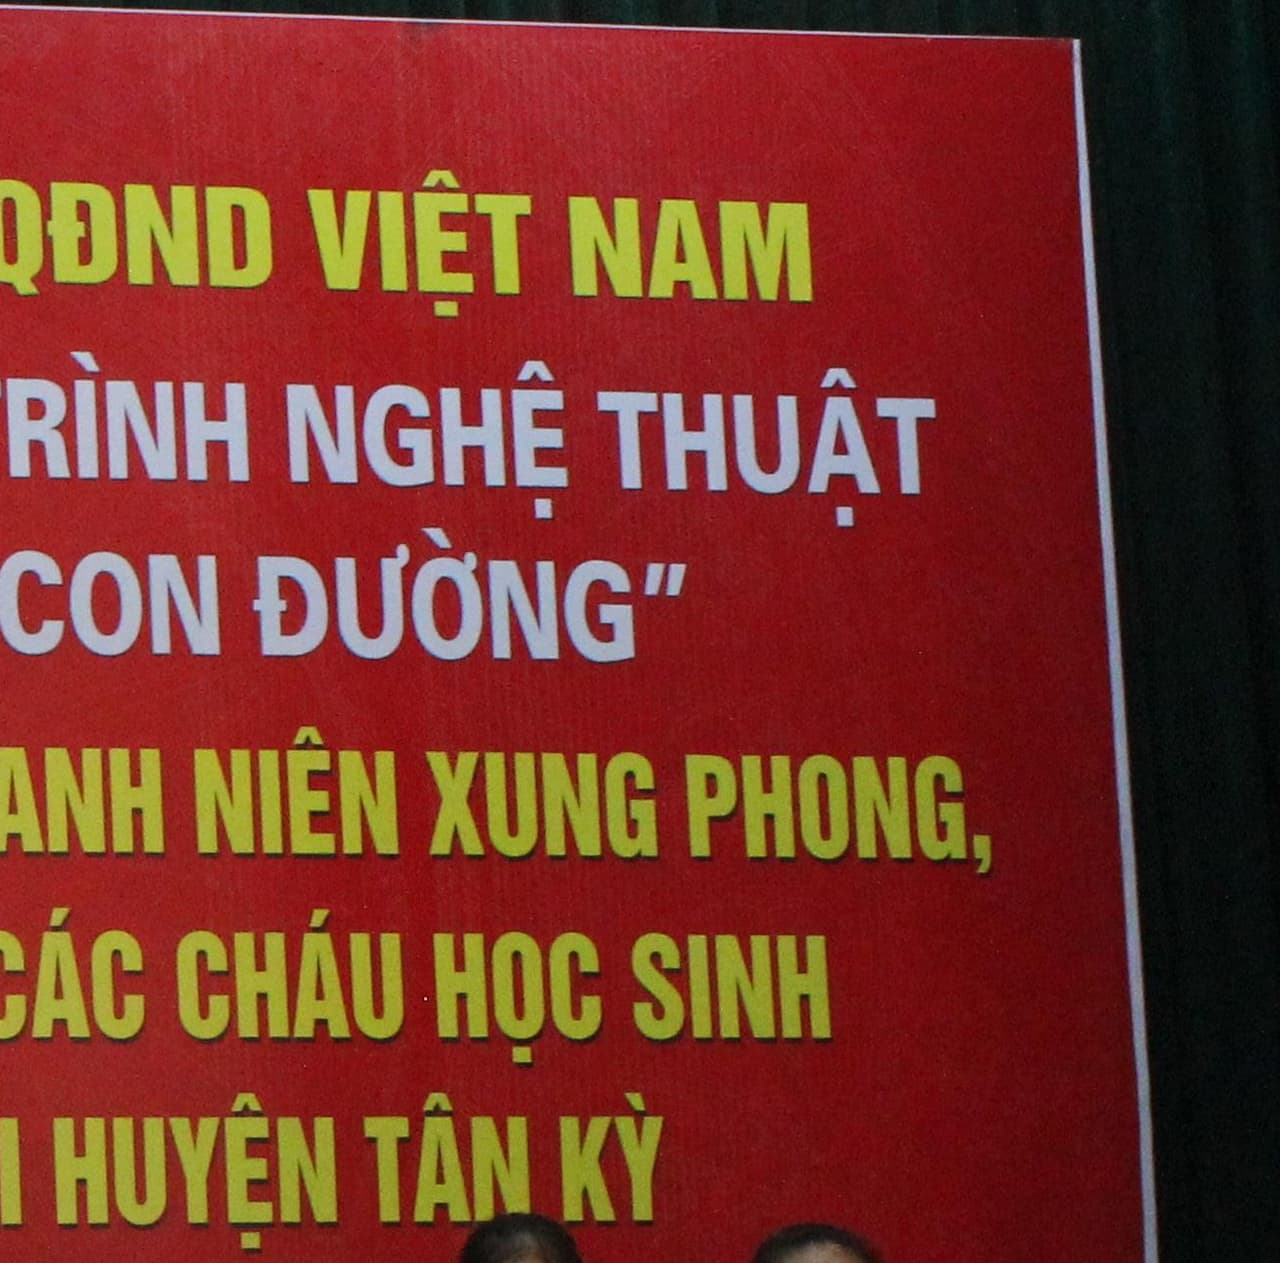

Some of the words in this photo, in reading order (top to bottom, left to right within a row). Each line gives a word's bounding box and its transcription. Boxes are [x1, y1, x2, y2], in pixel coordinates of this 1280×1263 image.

[308, 170, 532, 316] VIỆT
[568, 196, 812, 301] NAM
[287, 361, 568, 518] NGHỆ
[597, 368, 936, 526] THUẬT
[253, 528, 686, 662] ĐƯỜNG”
[194, 727, 399, 854] NIÊN
[426, 752, 657, 857] XUNG
[686, 755, 990, 872] PHONG,
[177, 909, 403, 1039] CHÁU
[434, 932, 601, 1062] HỌC
[632, 933, 830, 1039] SINH
[53, 1093, 337, 1248] HUYỆN
[364, 1093, 530, 1222] TÂN
[560, 1093, 663, 1221] KỲ
